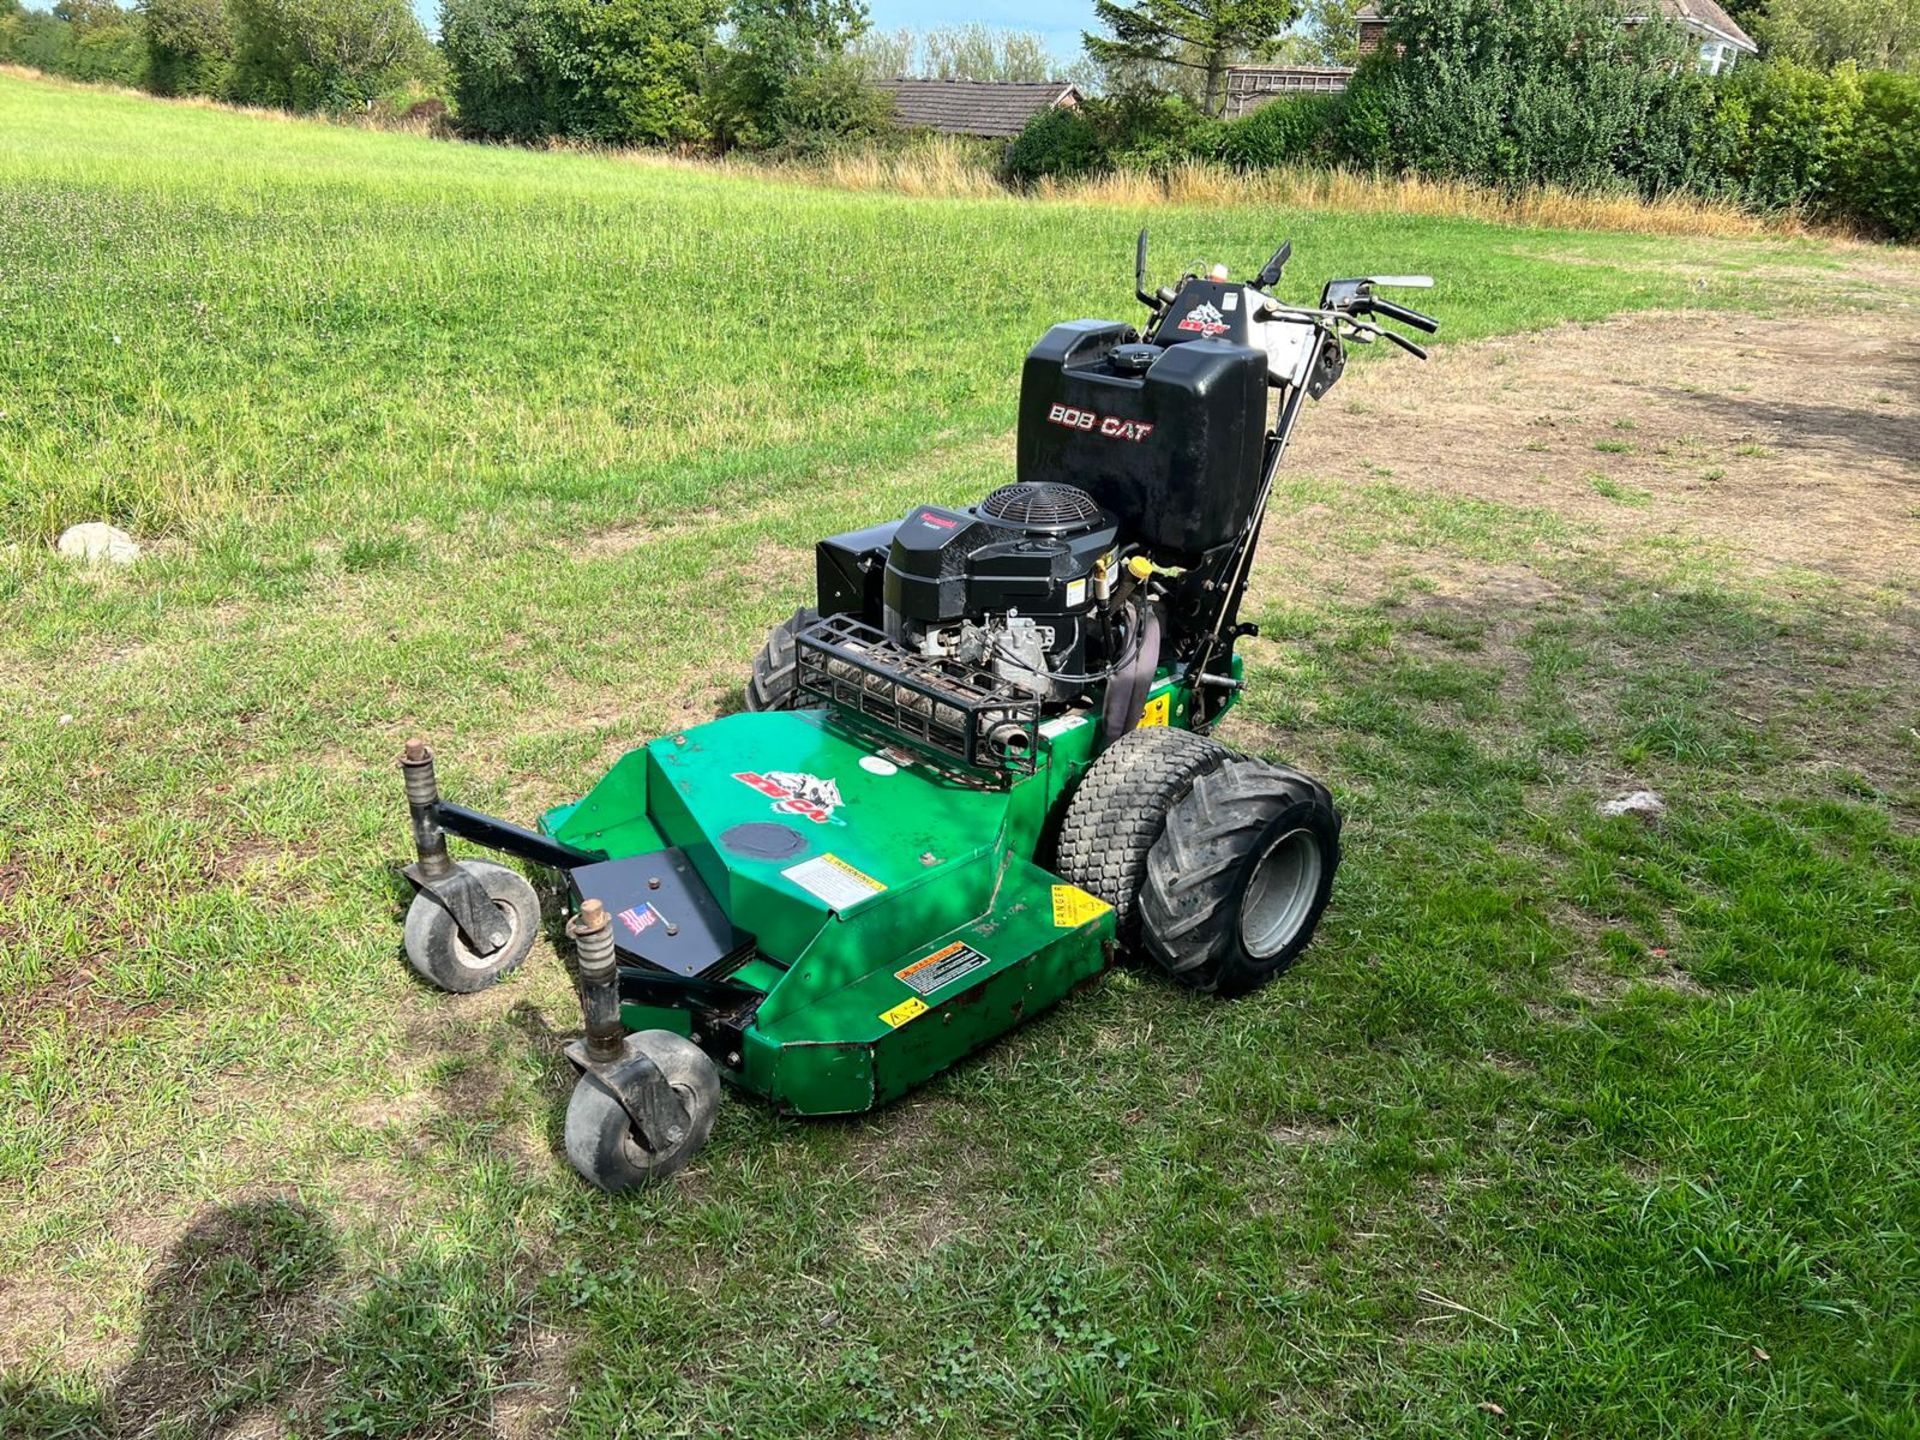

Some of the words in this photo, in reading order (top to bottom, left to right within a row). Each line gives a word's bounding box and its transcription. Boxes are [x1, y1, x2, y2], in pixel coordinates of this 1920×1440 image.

[1048, 403, 1096, 430] BOB
[1100, 416, 1154, 441] CAT
[1054, 886, 1066, 925] DANGER
